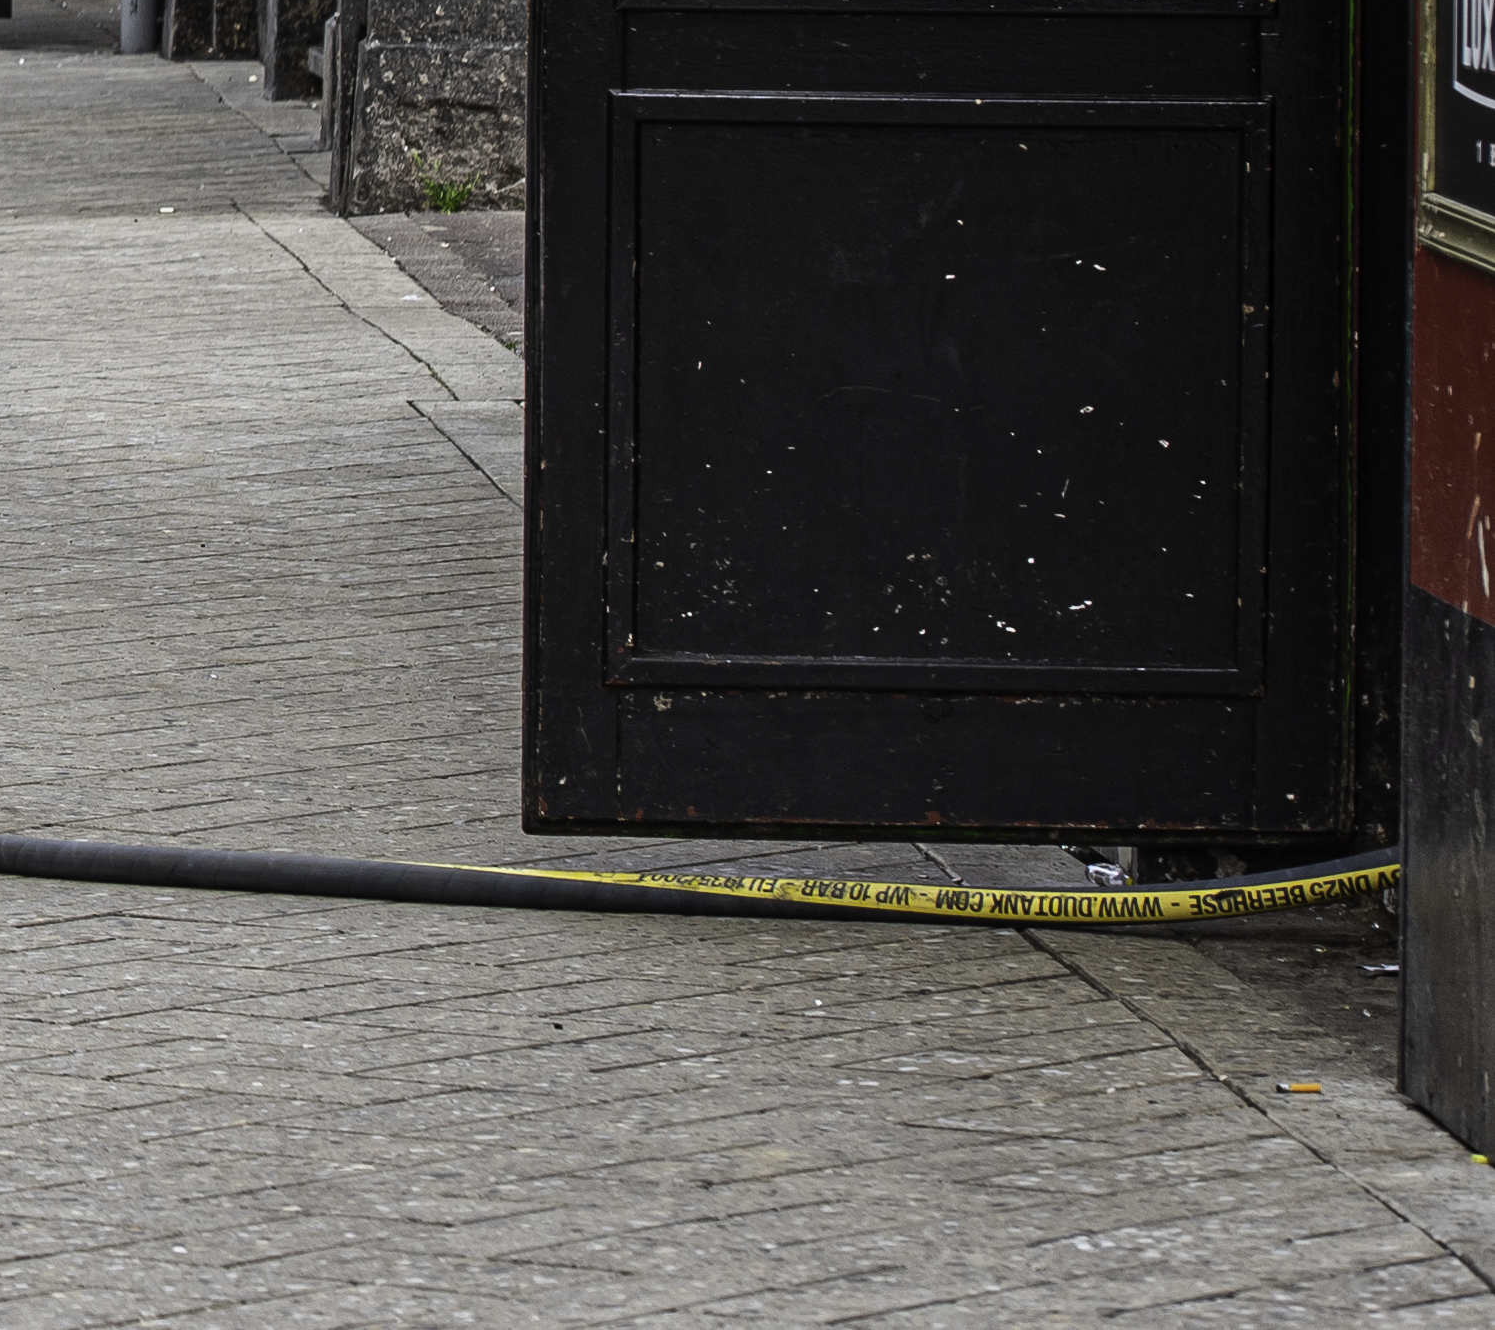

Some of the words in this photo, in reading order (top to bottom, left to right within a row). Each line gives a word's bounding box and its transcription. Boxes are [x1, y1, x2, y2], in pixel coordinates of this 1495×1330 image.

[801, 879, 848, 899] BAR
[876, 885, 912, 906] WP
[1189, 883, 1305, 917] BEERHOSE
[1308, 873, 1369, 900] DN25
[936, 889, 1164, 919] WWW.DUOTANK.COM
